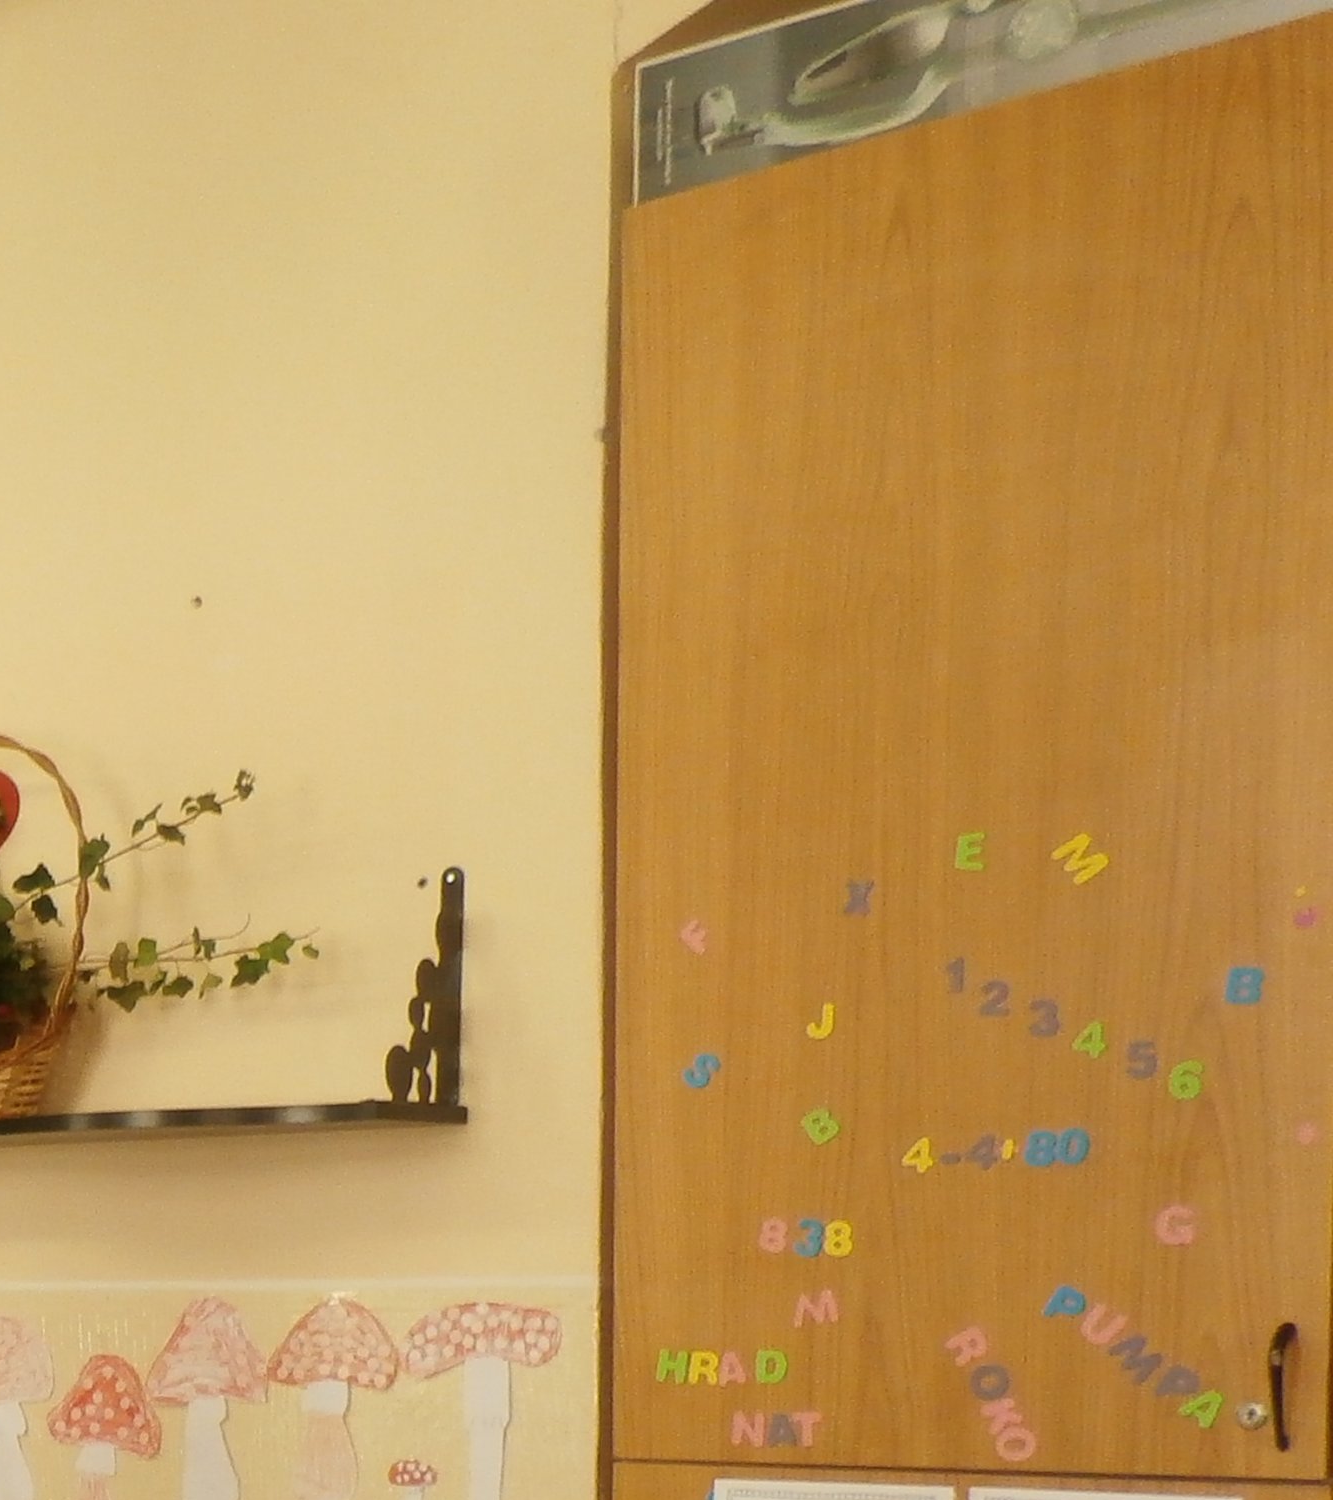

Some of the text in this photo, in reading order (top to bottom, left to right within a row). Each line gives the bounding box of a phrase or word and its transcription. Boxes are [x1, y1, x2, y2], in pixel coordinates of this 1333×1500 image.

[954, 831, 986, 872] E
[945, 956, 1204, 1100] 1 2 3 4 5 6
[655, 1348, 789, 1386] HRAD
